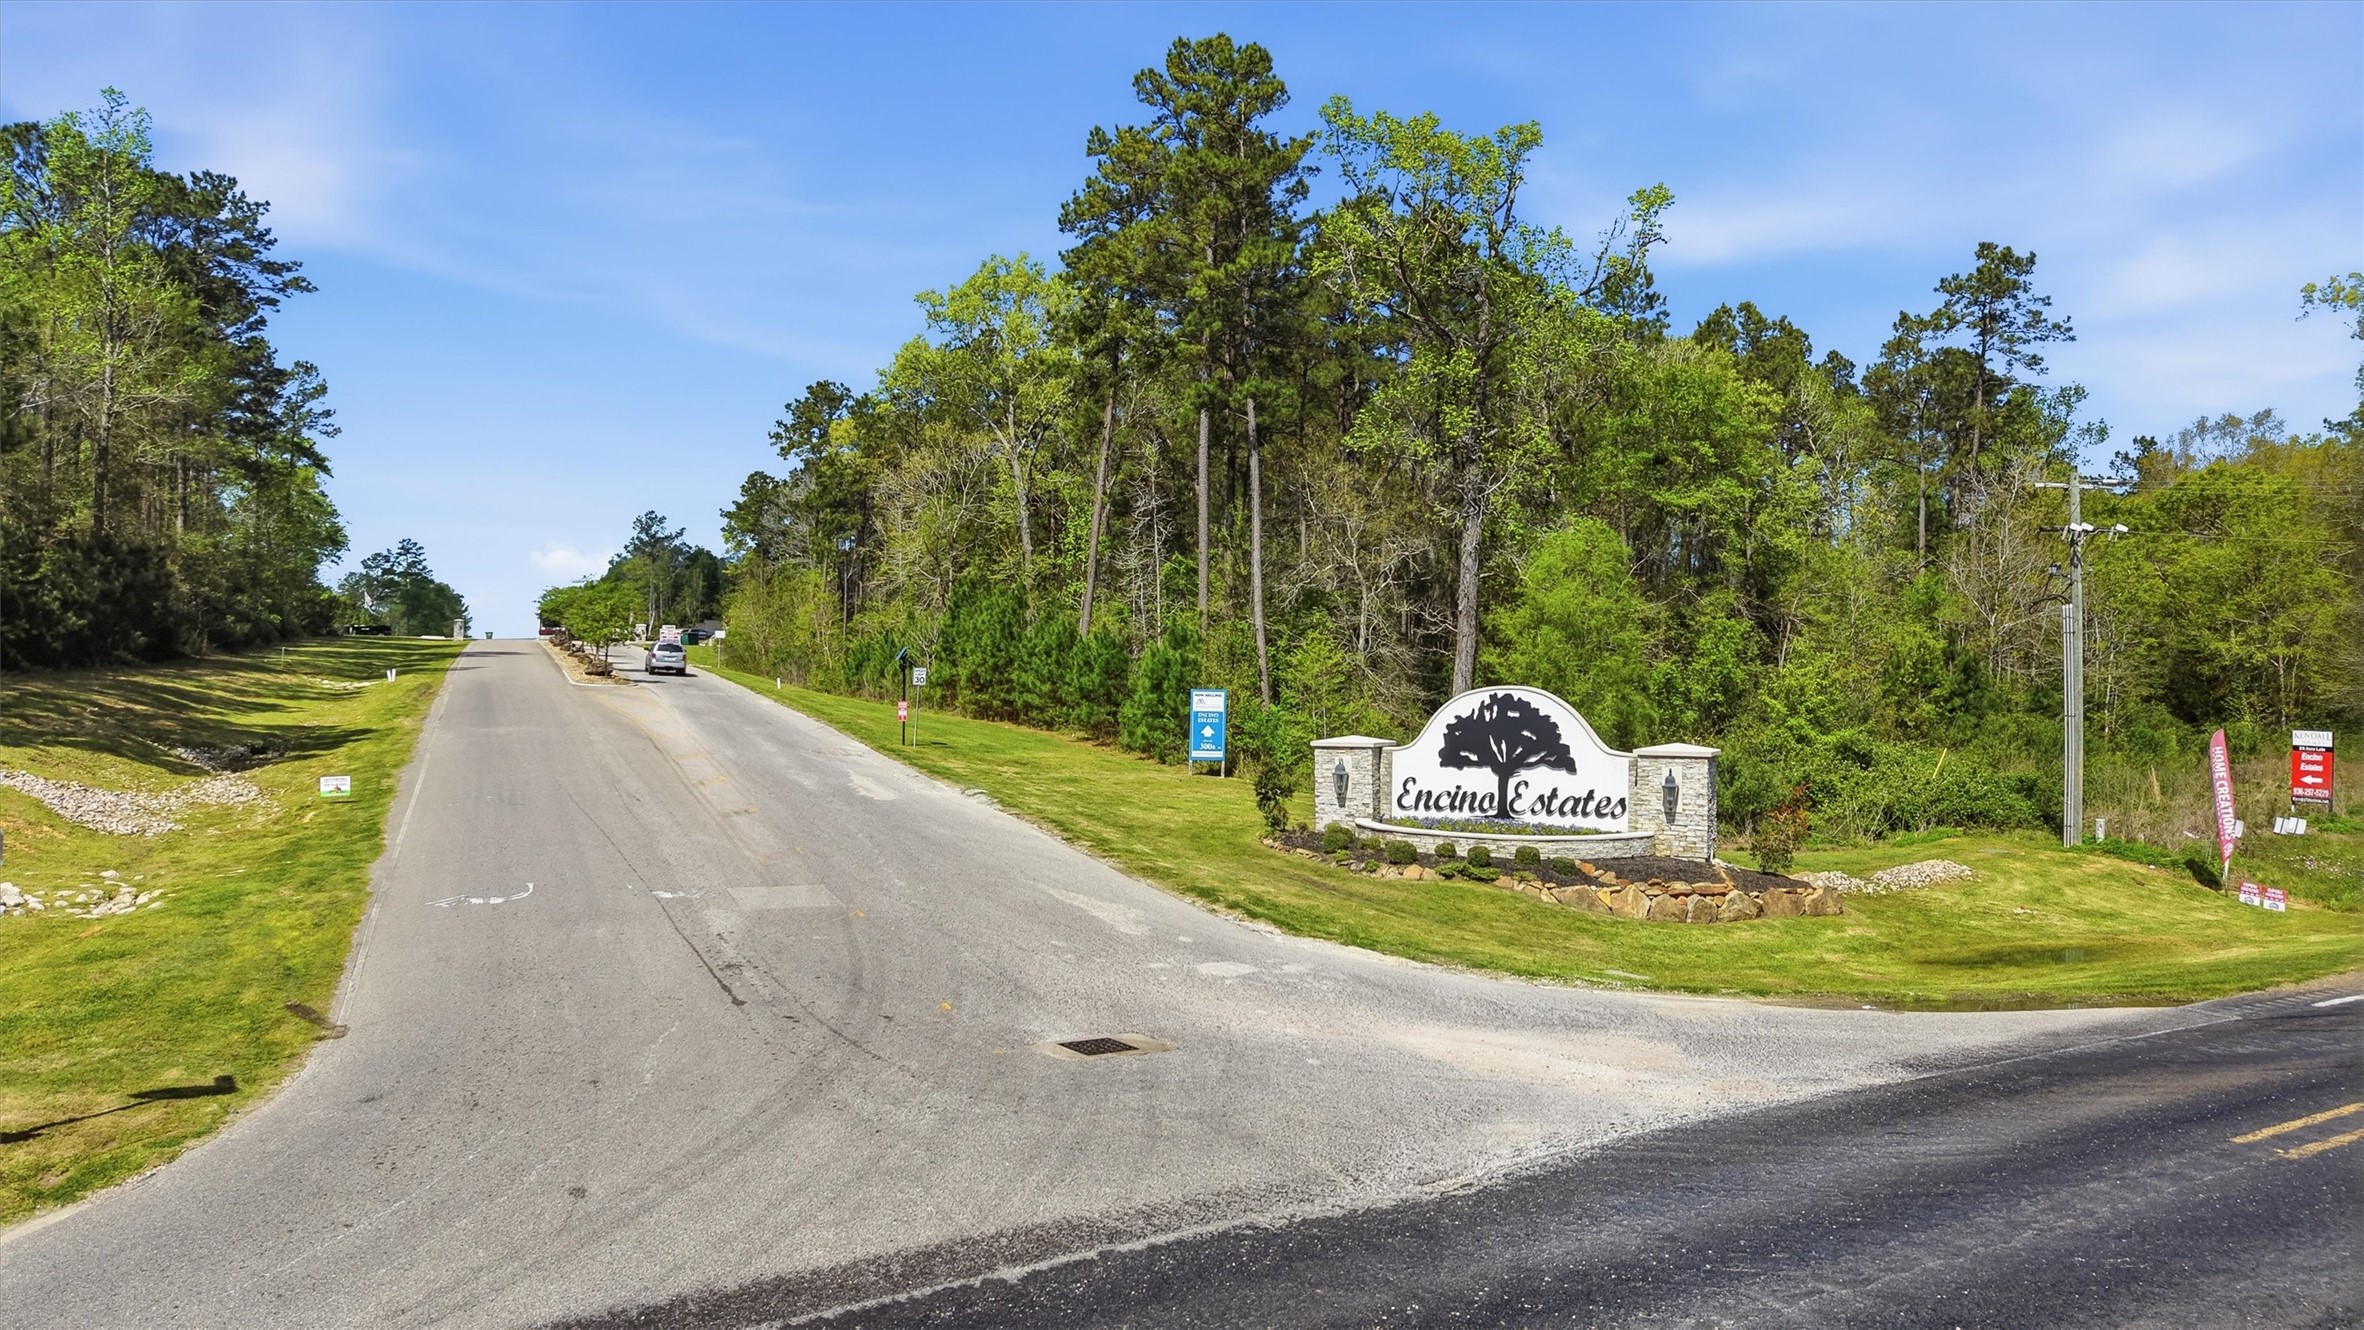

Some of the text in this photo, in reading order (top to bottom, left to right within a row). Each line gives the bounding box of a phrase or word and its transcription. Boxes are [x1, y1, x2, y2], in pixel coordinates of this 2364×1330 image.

[2293, 731, 2330, 741] KENDALL
[2212, 746, 2228, 782] HOME
[2300, 762, 2324, 772] Estates
[2301, 752, 2323, 761] Encino
[1397, 776, 1628, 820] Encino Estates
[2217, 781, 2236, 841] CREATIONS
